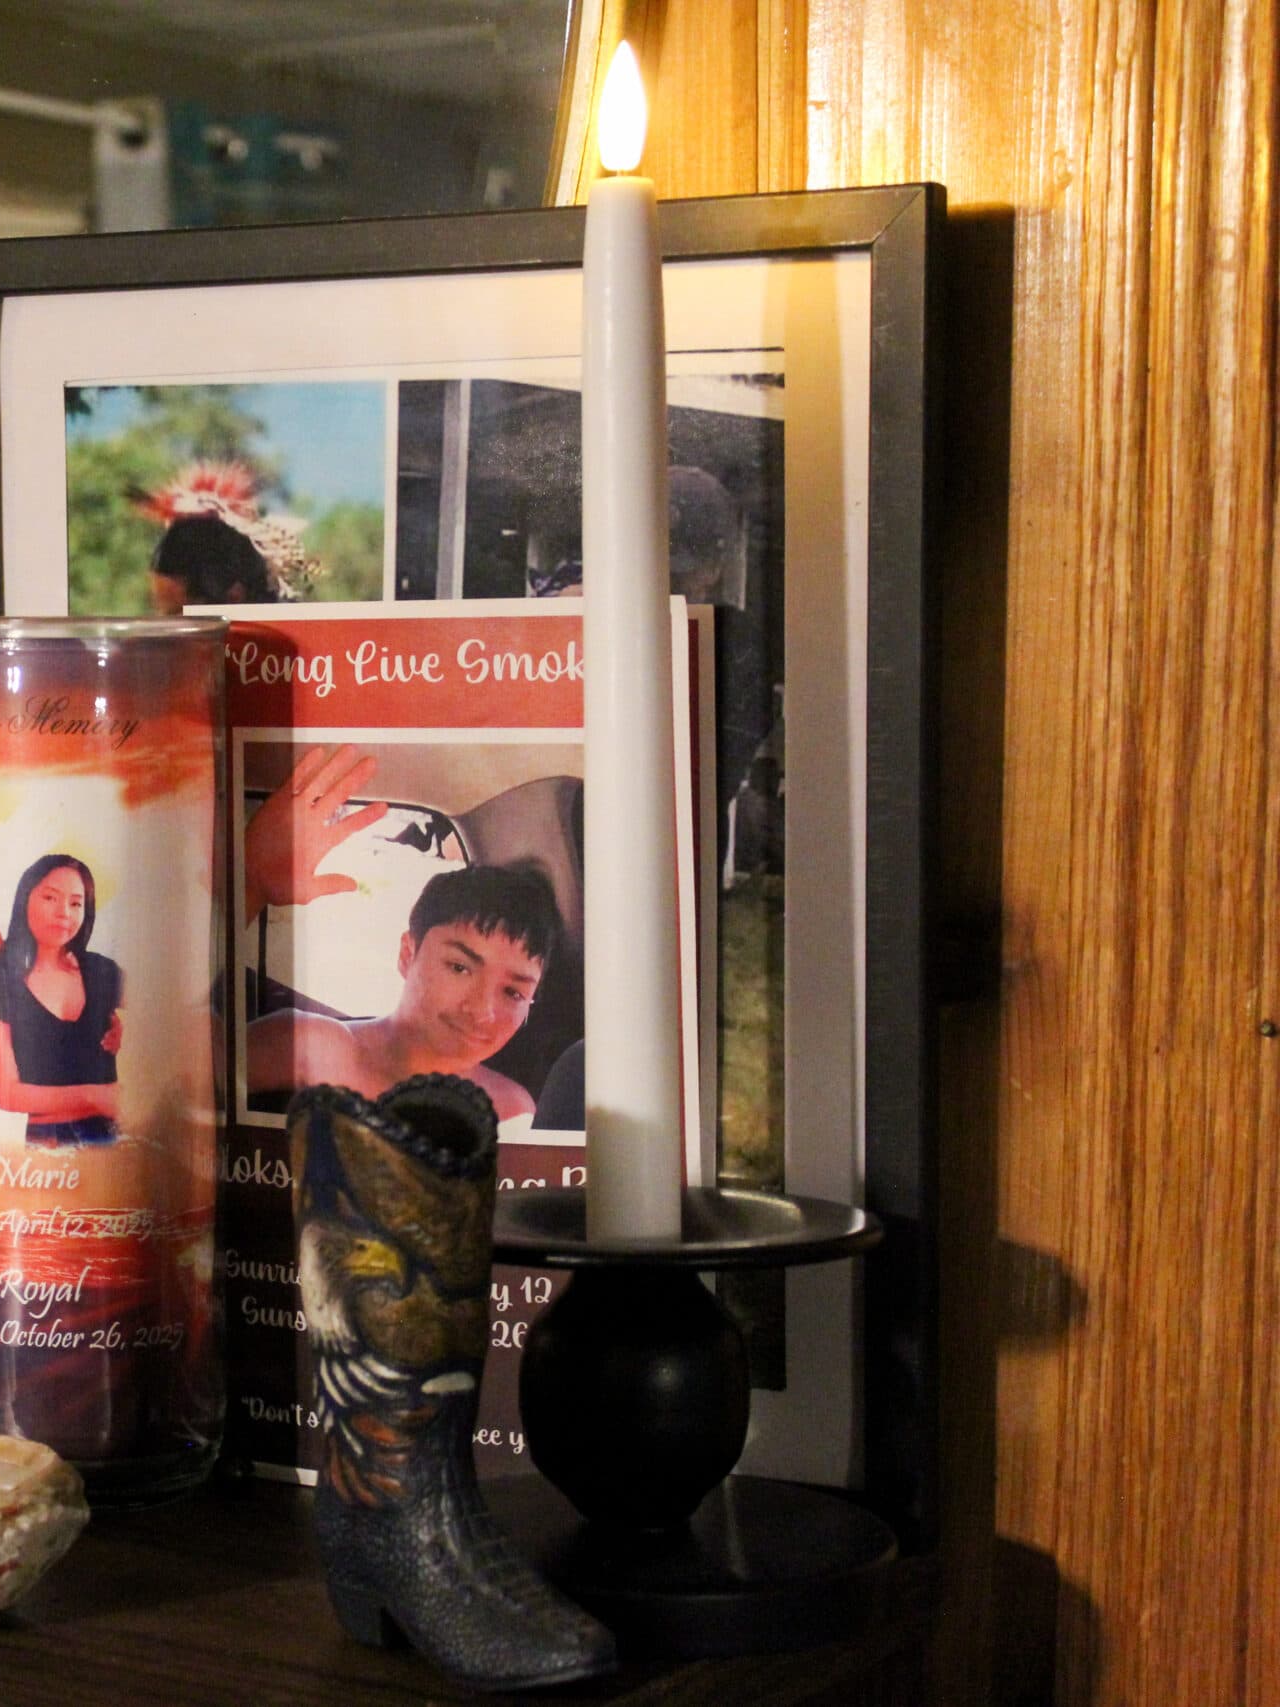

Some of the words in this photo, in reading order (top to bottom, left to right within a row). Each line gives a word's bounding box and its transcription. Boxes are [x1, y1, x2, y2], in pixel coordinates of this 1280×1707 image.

[345, 640, 446, 685] Live
[7, 696, 143, 750] Memory
[225, 1248, 303, 1287] Sunri
[0, 1318, 85, 1349] October
[132, 1322, 185, 1350] 2025
